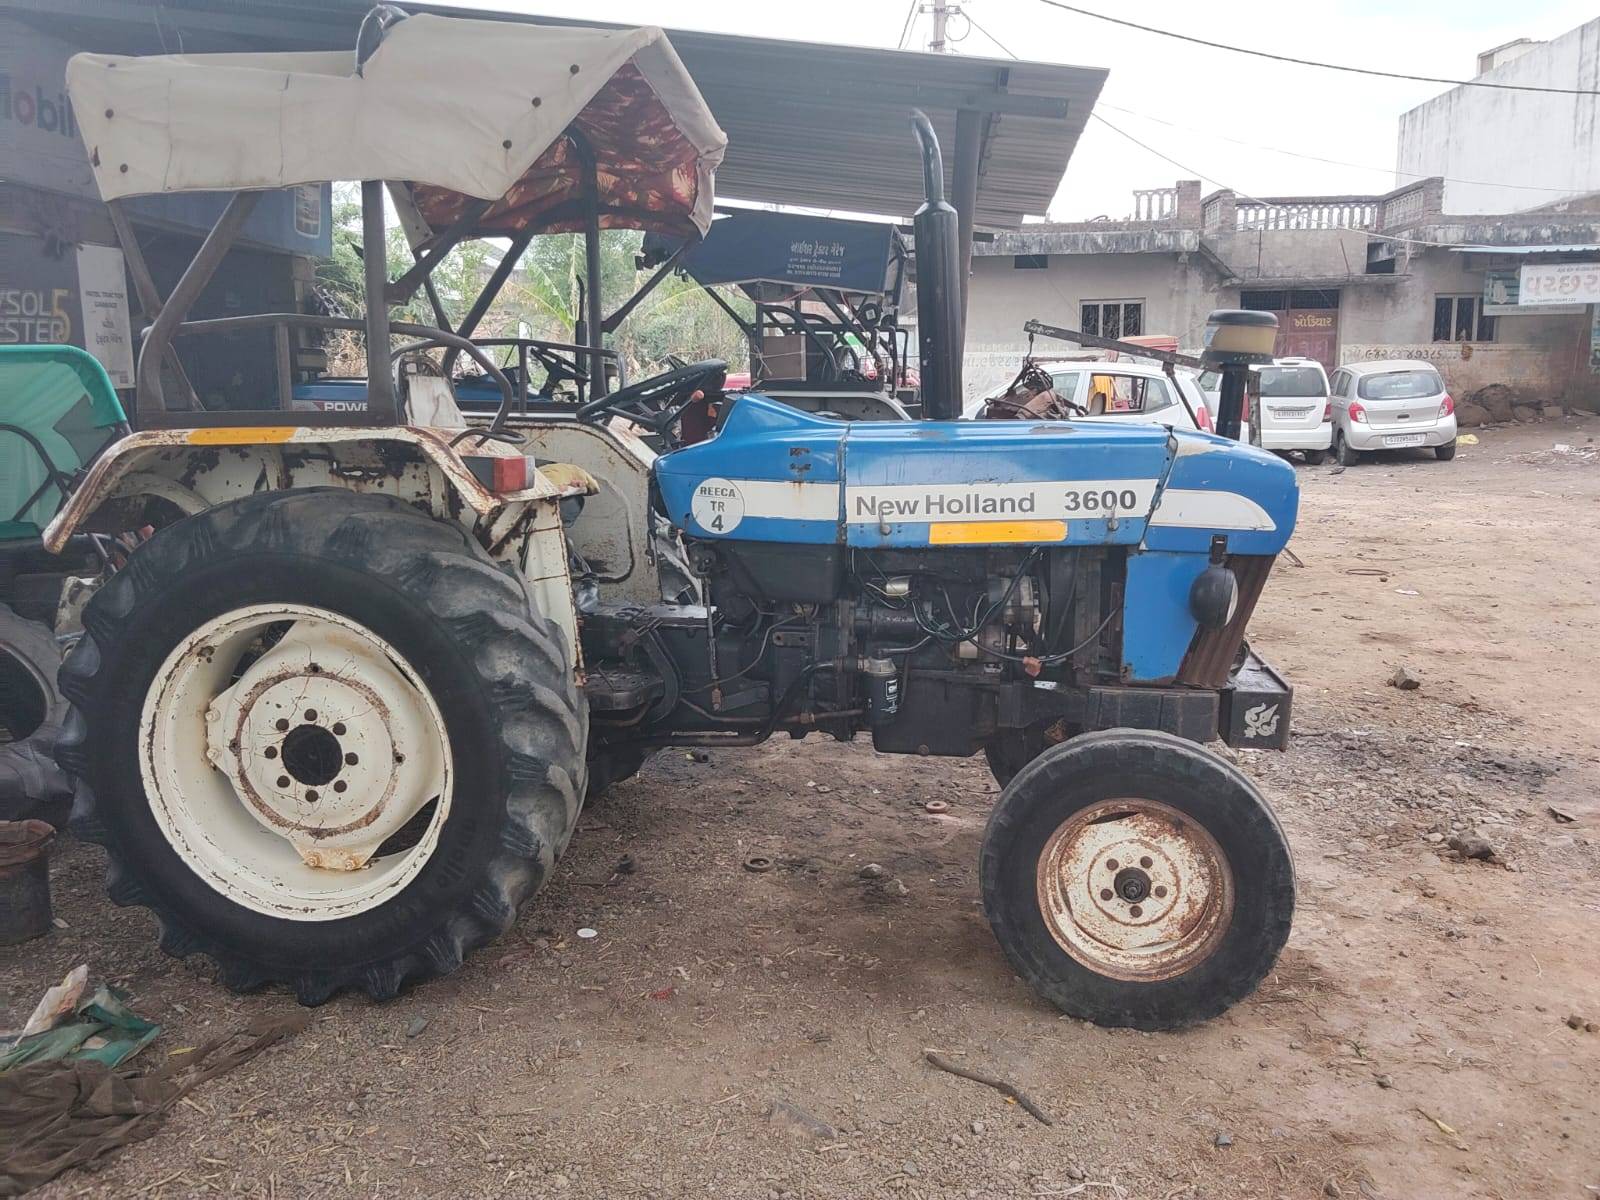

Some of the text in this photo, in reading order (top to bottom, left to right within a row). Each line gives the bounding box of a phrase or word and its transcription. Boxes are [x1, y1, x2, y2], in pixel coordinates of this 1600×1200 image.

[0, 84, 74, 138] obil
[700, 486, 736, 498] REECA
[710, 500, 725, 512] TR
[856, 489, 1137, 516] New Holland 3600
[711, 514, 724, 531] 4
